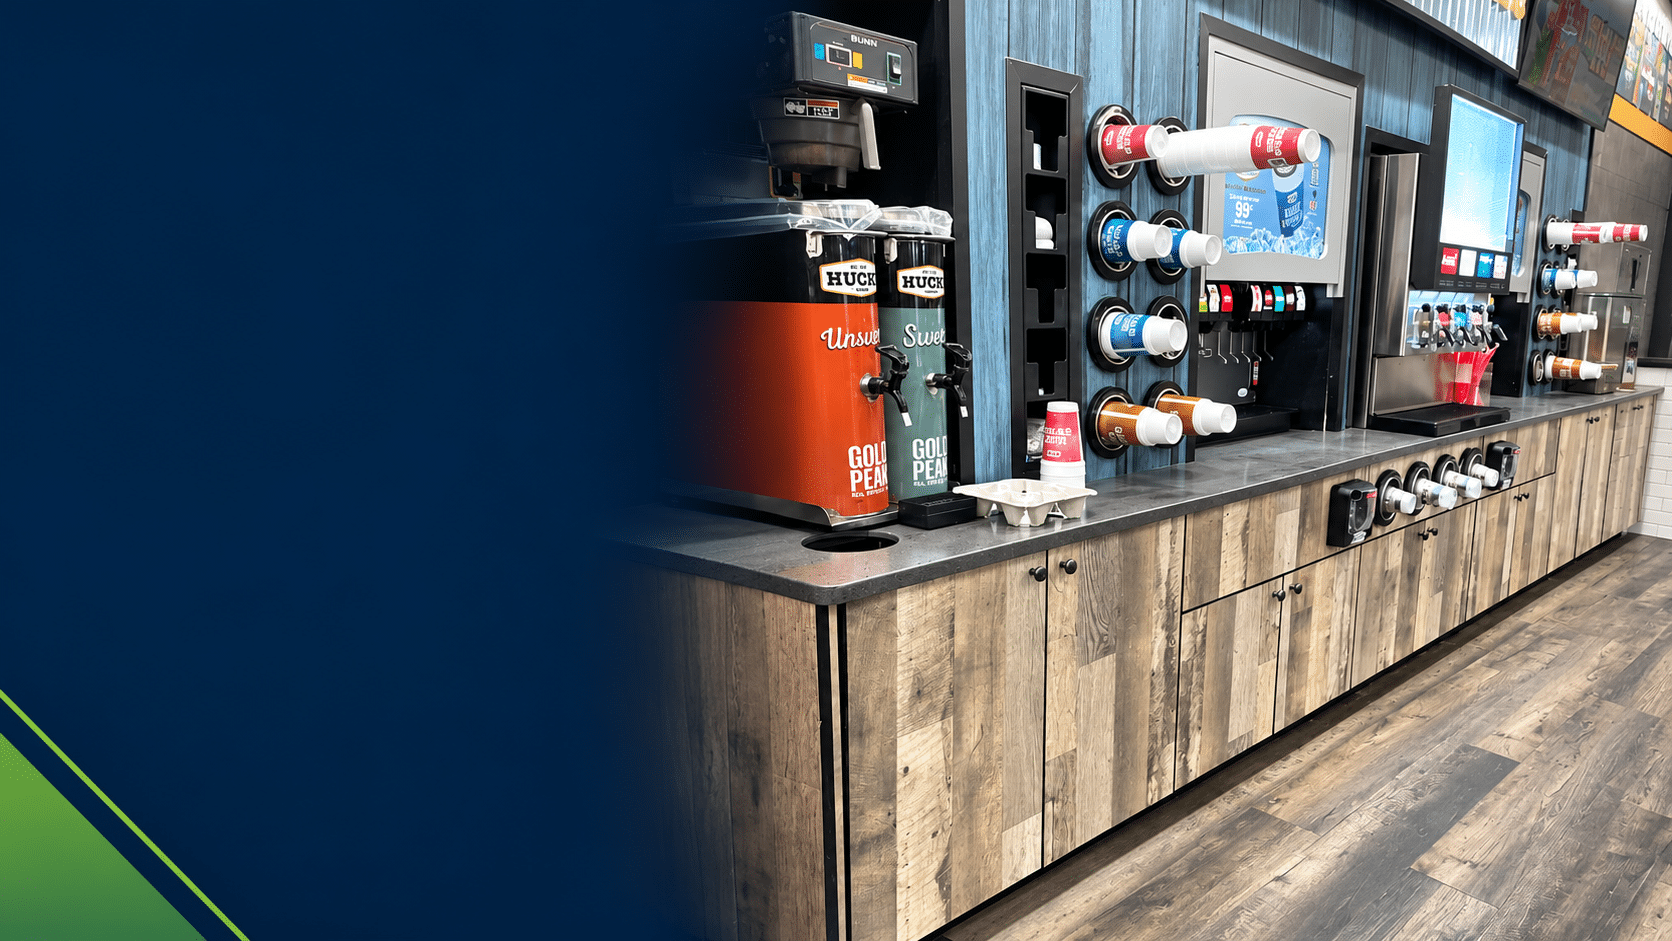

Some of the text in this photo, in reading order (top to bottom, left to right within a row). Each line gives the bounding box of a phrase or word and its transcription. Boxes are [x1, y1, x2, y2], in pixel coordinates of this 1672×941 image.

[851, 34, 878, 48] BUNN
[826, 271, 876, 287] HUCK
[902, 275, 944, 289] HUCK
[848, 440, 887, 469] GOLD
[912, 435, 947, 460] GOLD
[850, 463, 889, 492] PEAK
[912, 456, 948, 481] PEAK
